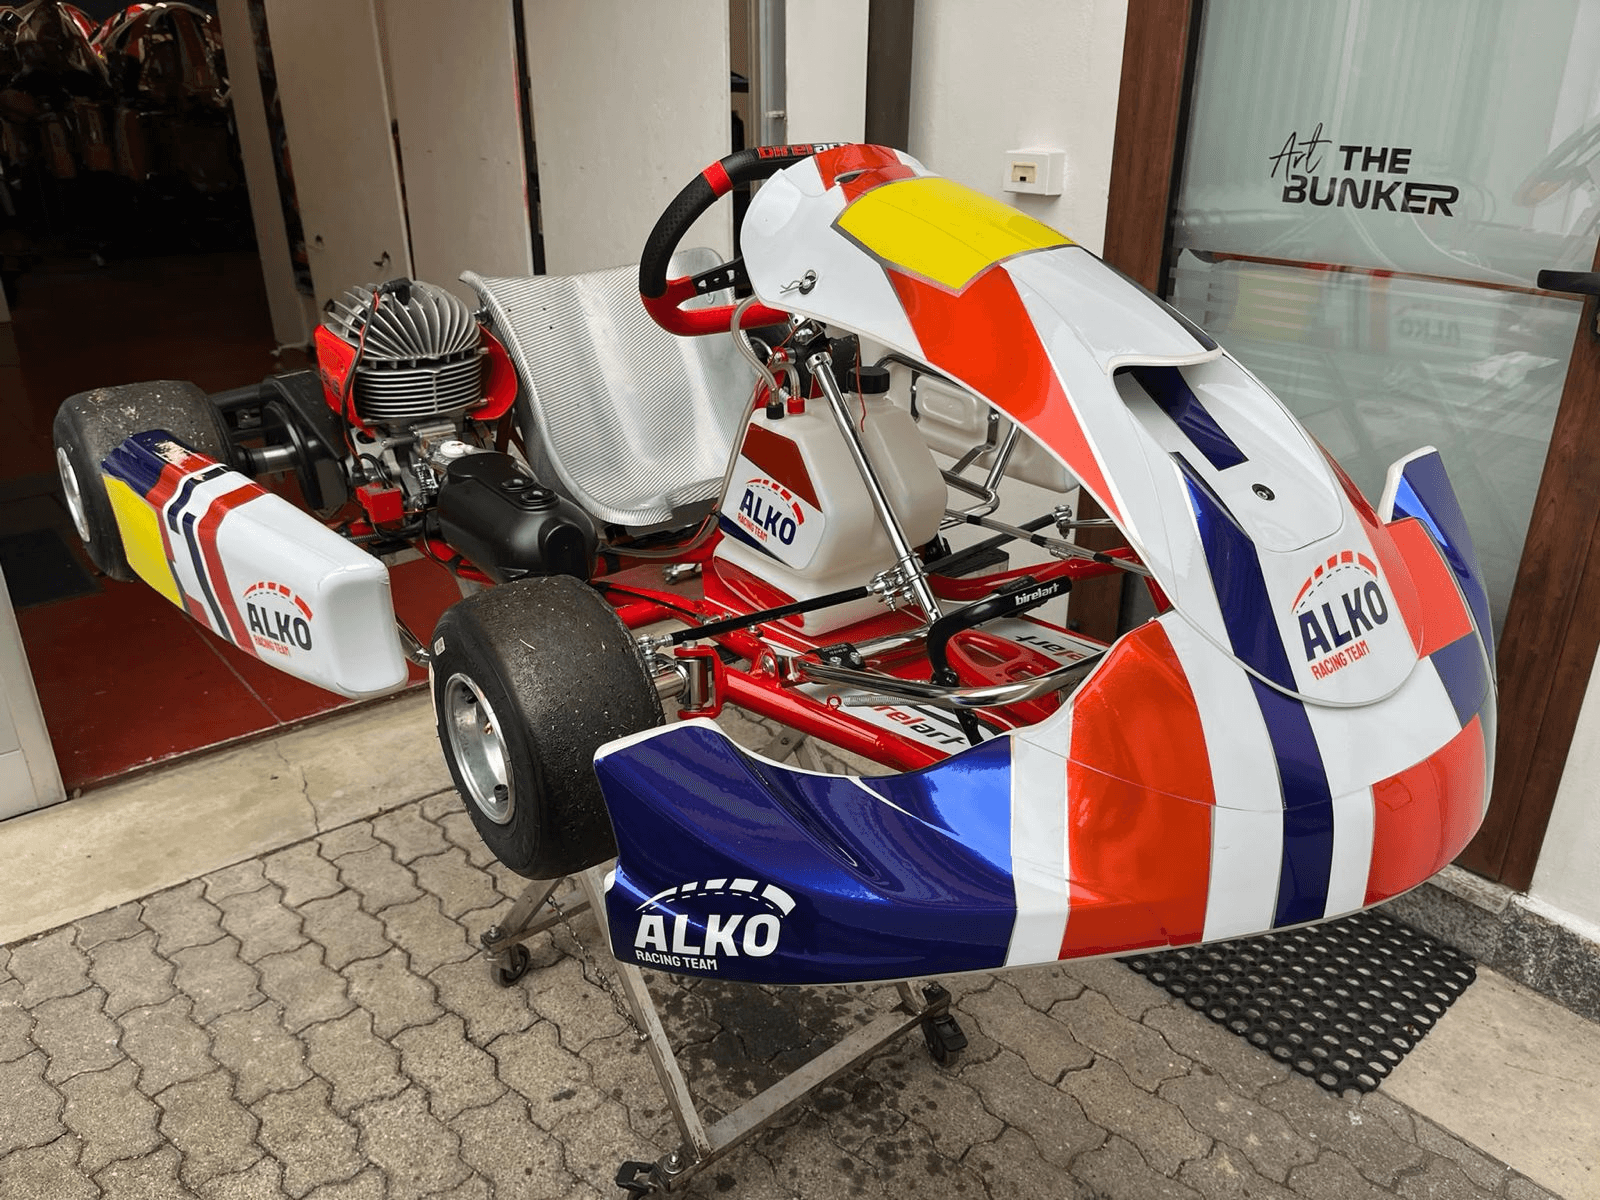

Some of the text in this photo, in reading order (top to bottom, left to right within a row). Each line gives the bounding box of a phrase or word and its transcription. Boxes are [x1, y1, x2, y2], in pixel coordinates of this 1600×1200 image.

[1269, 122, 1412, 183] Art THE
[1281, 174, 1460, 217] BUNKER
[739, 488, 797, 546] ALKO
[1015, 583, 1060, 606] birelart
[246, 602, 312, 651] ALKO
[1298, 580, 1389, 662] ALKO
[1014, 635, 1088, 662] elart
[1311, 640, 1371, 680] RACING TEAM
[872, 705, 966, 745] relart
[633, 913, 781, 958] ALKO
[635, 950, 718, 971] RACING TEAM
